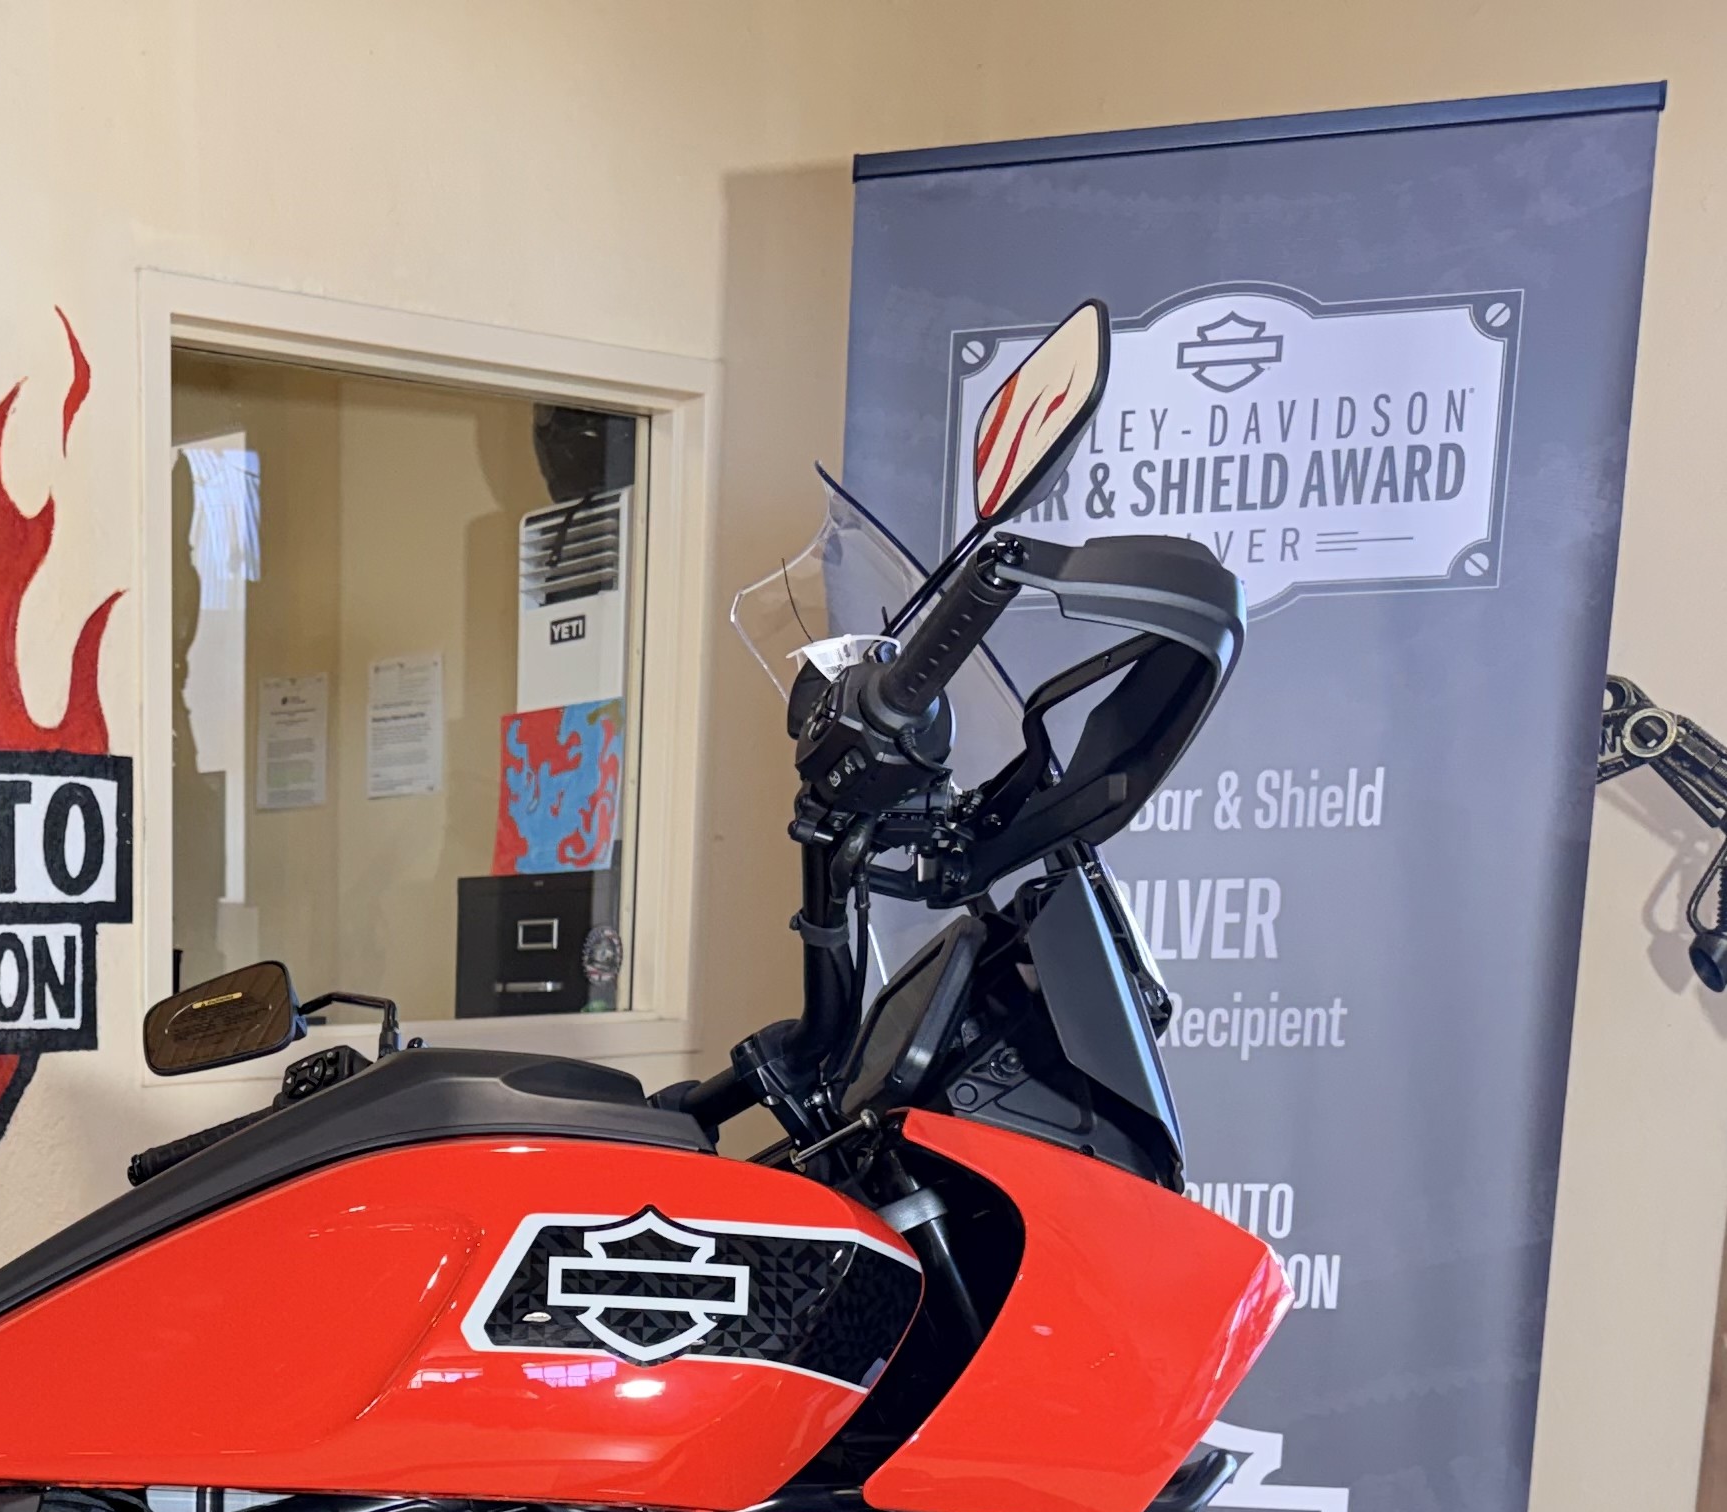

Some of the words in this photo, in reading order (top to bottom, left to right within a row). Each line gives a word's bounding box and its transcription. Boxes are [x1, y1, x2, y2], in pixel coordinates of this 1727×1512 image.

[1089, 389, 1467, 455] LEY-DAVIDSON
[1085, 462, 1116, 519] &
[1129, 453, 1289, 517] SHIELD
[1299, 443, 1466, 508] AWARD
[551, 619, 584, 641] YETI
[1213, 770, 1242, 831] &
[1254, 767, 1385, 829] Shield
[1116, 877, 1282, 960] ILVER
[1157, 992, 1349, 1061] Recipient
